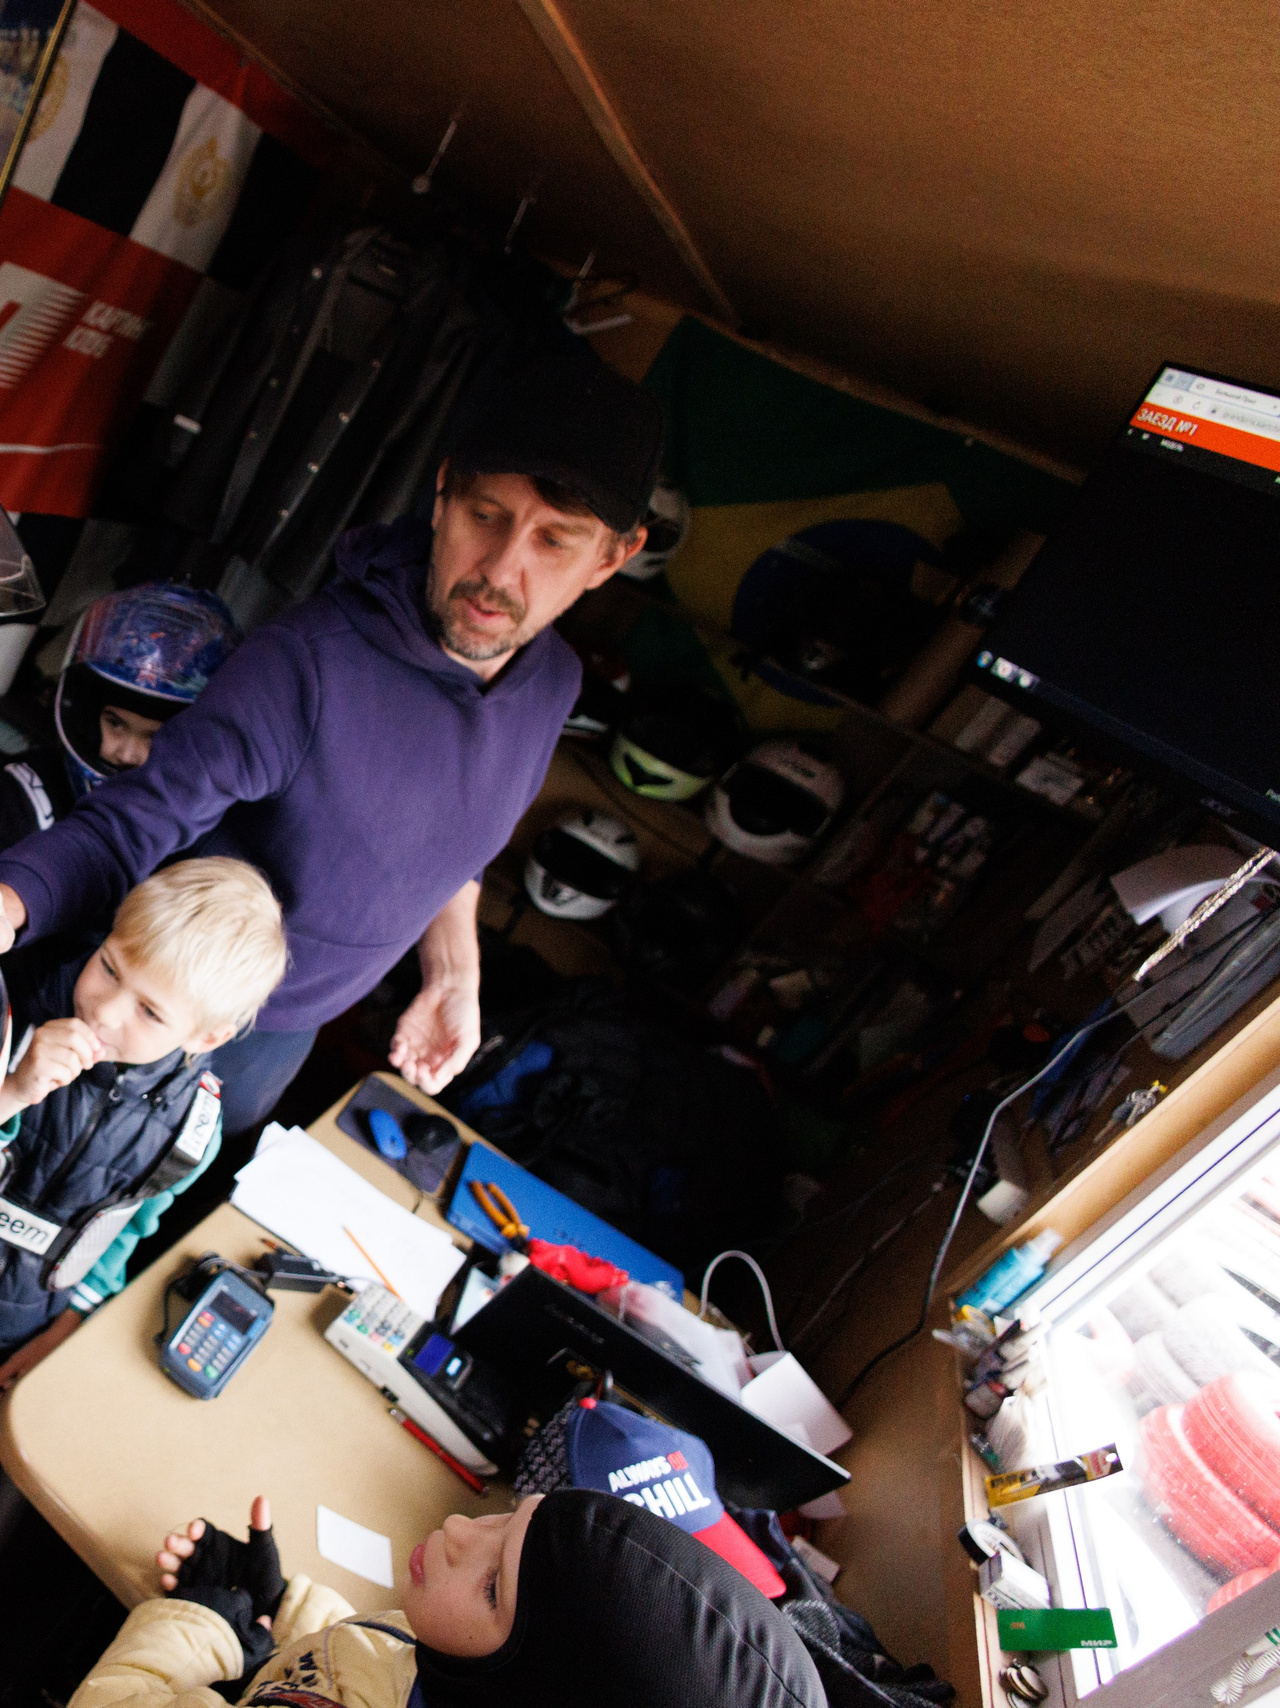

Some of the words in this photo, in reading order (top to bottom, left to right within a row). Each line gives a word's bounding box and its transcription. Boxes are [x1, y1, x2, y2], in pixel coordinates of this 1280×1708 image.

[1136, 407, 1177, 433] ЗАЕЗД
[1174, 419, 1198, 436] №1
[608, 1455, 672, 1493] ALWAYS
